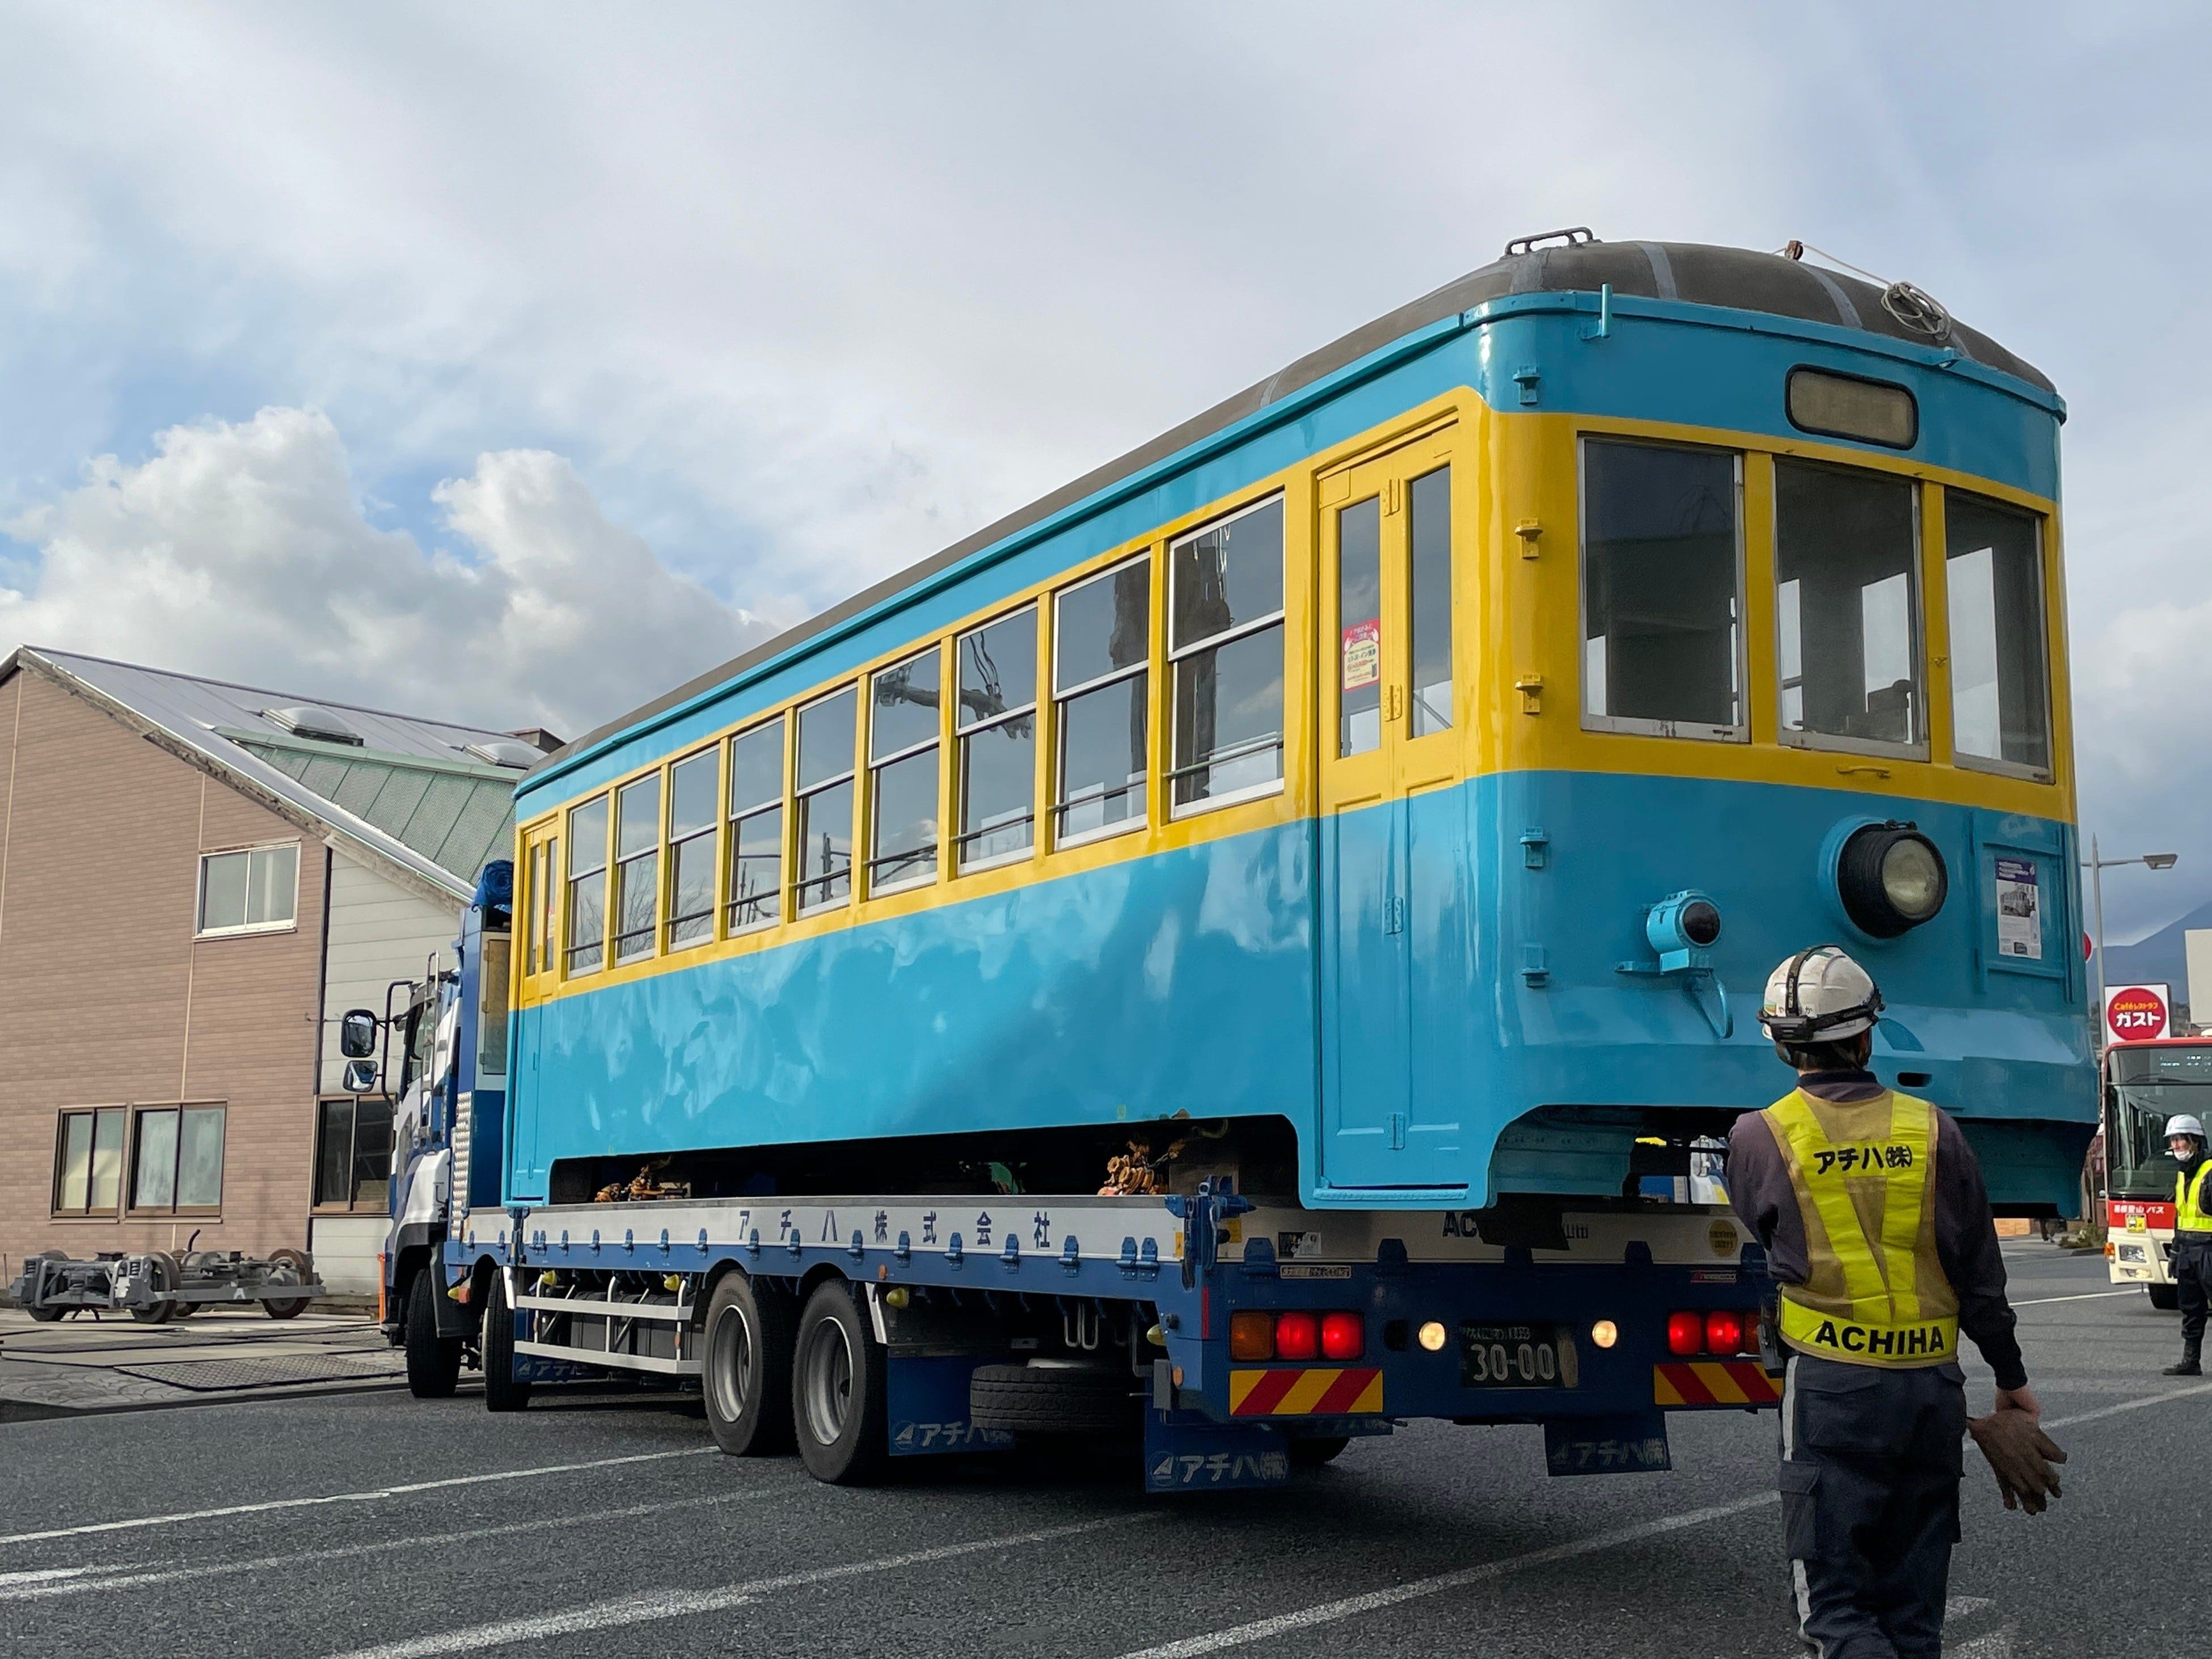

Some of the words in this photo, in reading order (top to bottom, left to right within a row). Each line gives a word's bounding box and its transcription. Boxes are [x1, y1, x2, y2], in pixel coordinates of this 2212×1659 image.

[2116, 1012, 2161, 1028] ガスト
[738, 1209, 1050, 1248] アチハ株式会社
[1815, 1320, 1944, 1355] ACHIHA
